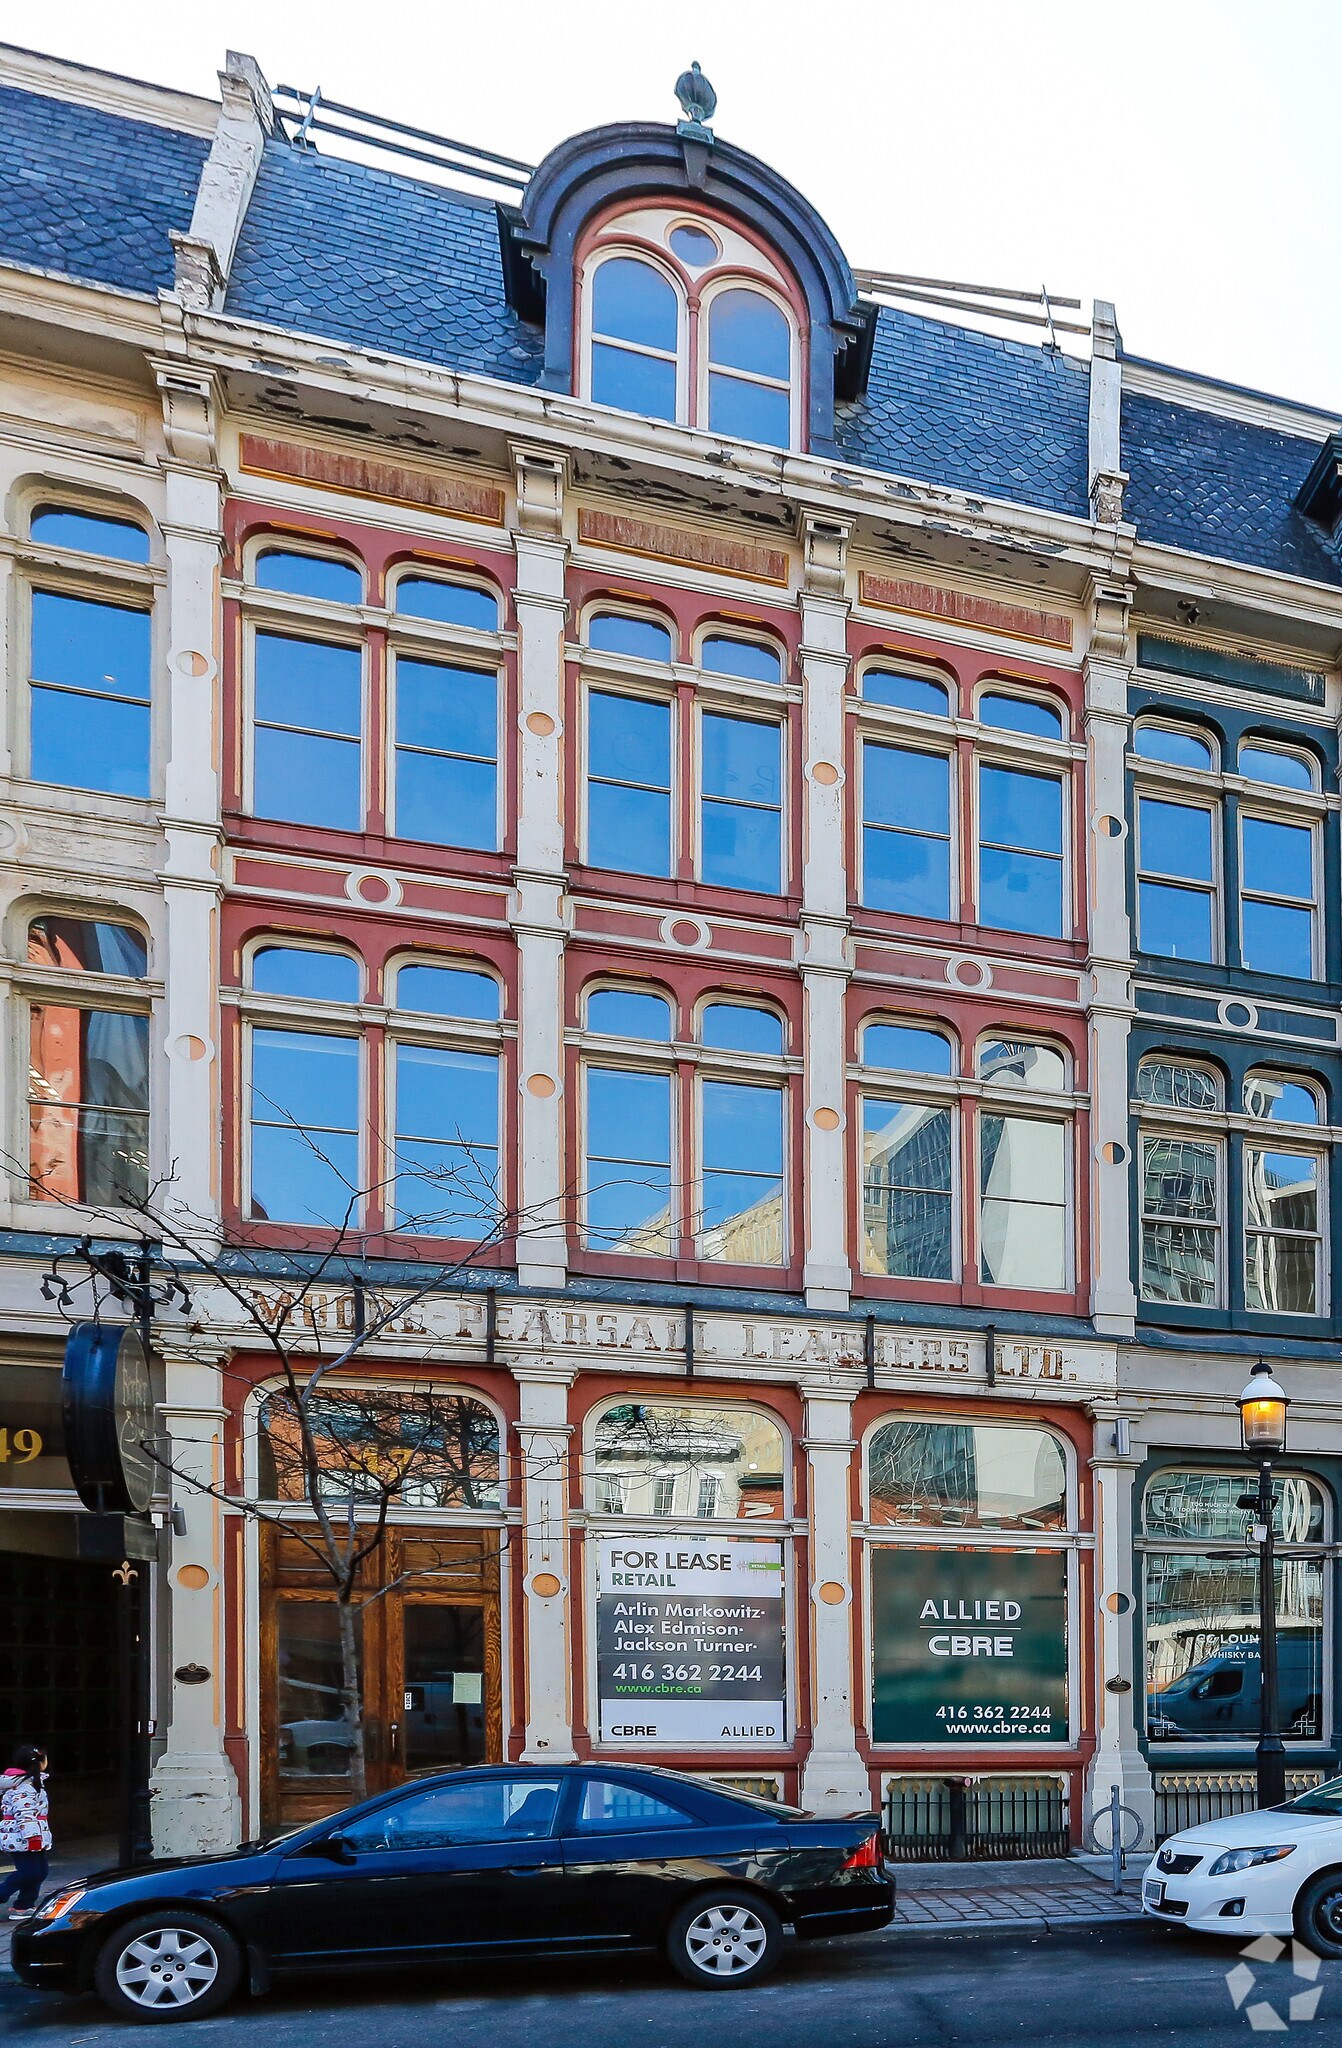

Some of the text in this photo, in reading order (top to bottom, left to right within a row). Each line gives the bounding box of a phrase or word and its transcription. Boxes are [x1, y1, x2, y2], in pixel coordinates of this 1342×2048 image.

[610, 1550, 732, 1571] FOR LEASE
[612, 1572, 676, 1587] RETAIL
[613, 1602, 659, 1617] Arlin
[919, 1599, 1022, 1621] ALLIED
[613, 1619, 655, 1634] Alex
[613, 1637, 688, 1652] Jackson
[928, 1635, 1014, 1657] CBRE
[1220, 1633, 1279, 1645] LOUN
[1209, 1651, 1262, 1659] WHISKY BA
[612, 1663, 762, 1682] 416 362 2244
[615, 1683, 703, 1694] www.cbre.ca
[935, 1706, 1052, 1719] 416 362 2244
[611, 1725, 657, 1737] CBRE
[720, 1726, 776, 1738] ALLIED
[945, 1720, 1051, 1734] www.cbre.ca
